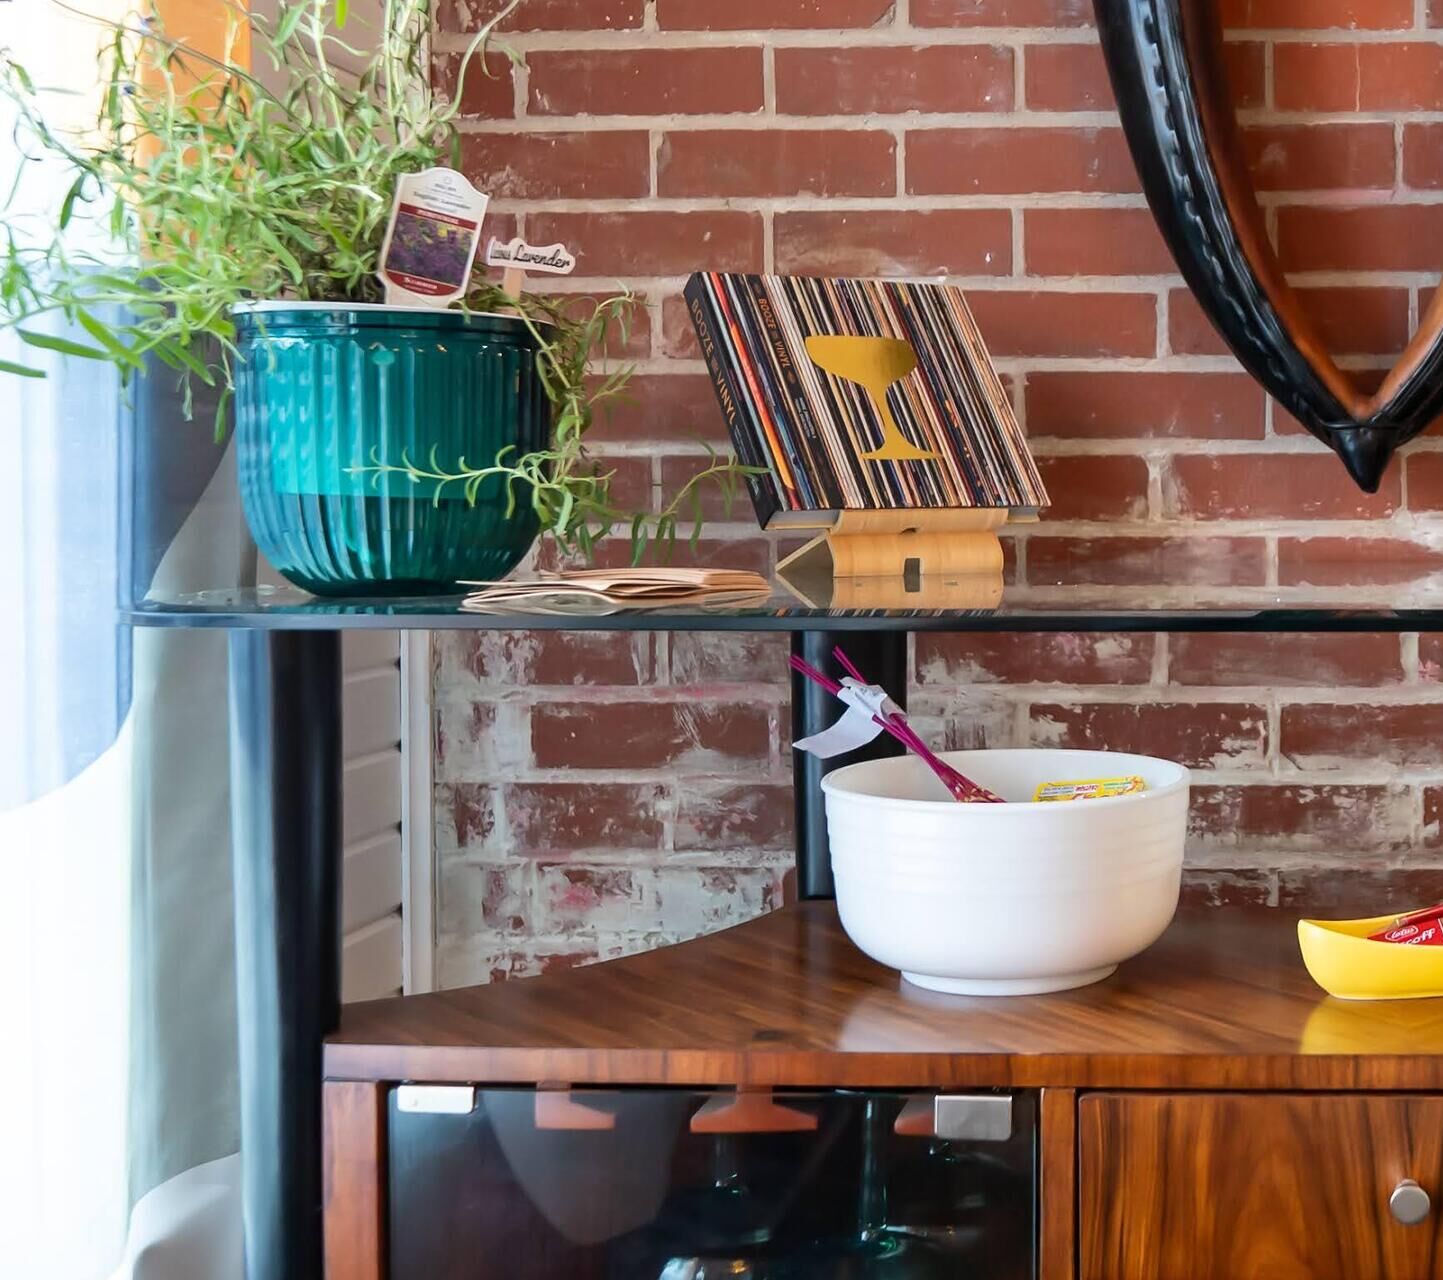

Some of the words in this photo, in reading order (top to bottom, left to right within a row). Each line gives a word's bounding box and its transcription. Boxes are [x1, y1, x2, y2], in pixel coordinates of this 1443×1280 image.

[513, 244, 570, 268] Lavender
[758, 297, 777, 329] BOOZE
[775, 340, 791, 368] VINYL
[691, 298, 714, 355] BOOZE
[716, 371, 736, 424] VINYL
[1398, 928, 1435, 944] coff
